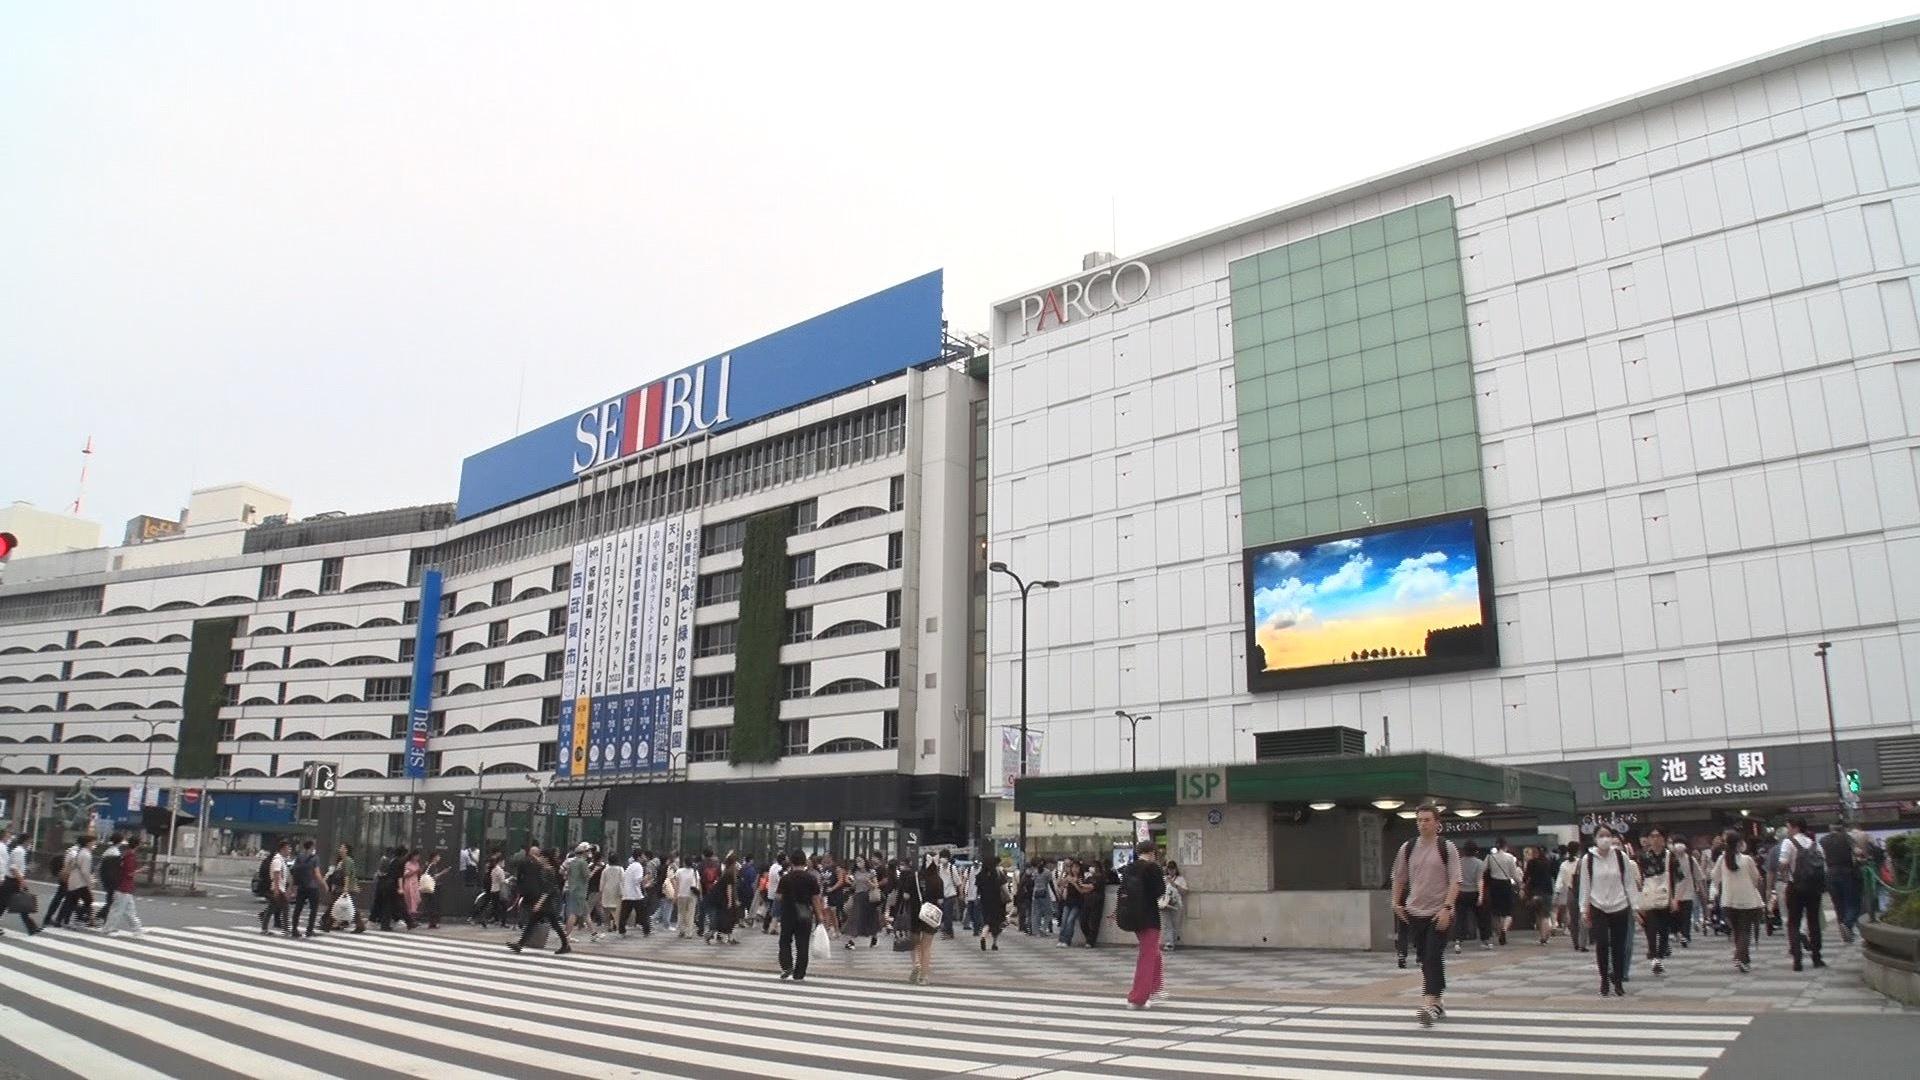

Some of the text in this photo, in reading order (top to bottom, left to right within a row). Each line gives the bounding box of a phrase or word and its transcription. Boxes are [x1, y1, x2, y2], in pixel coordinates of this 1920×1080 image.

[1020, 261, 1150, 336] PARCO
[573, 355, 733, 473] SEIBU
[411, 709, 429, 767] SEIBU
[1600, 759, 1651, 790] JR
[1661, 752, 1766, 783] 池袋駅
[1181, 772, 1221, 800] ISP
[1662, 782, 1768, 797] Ikebukuro Station
